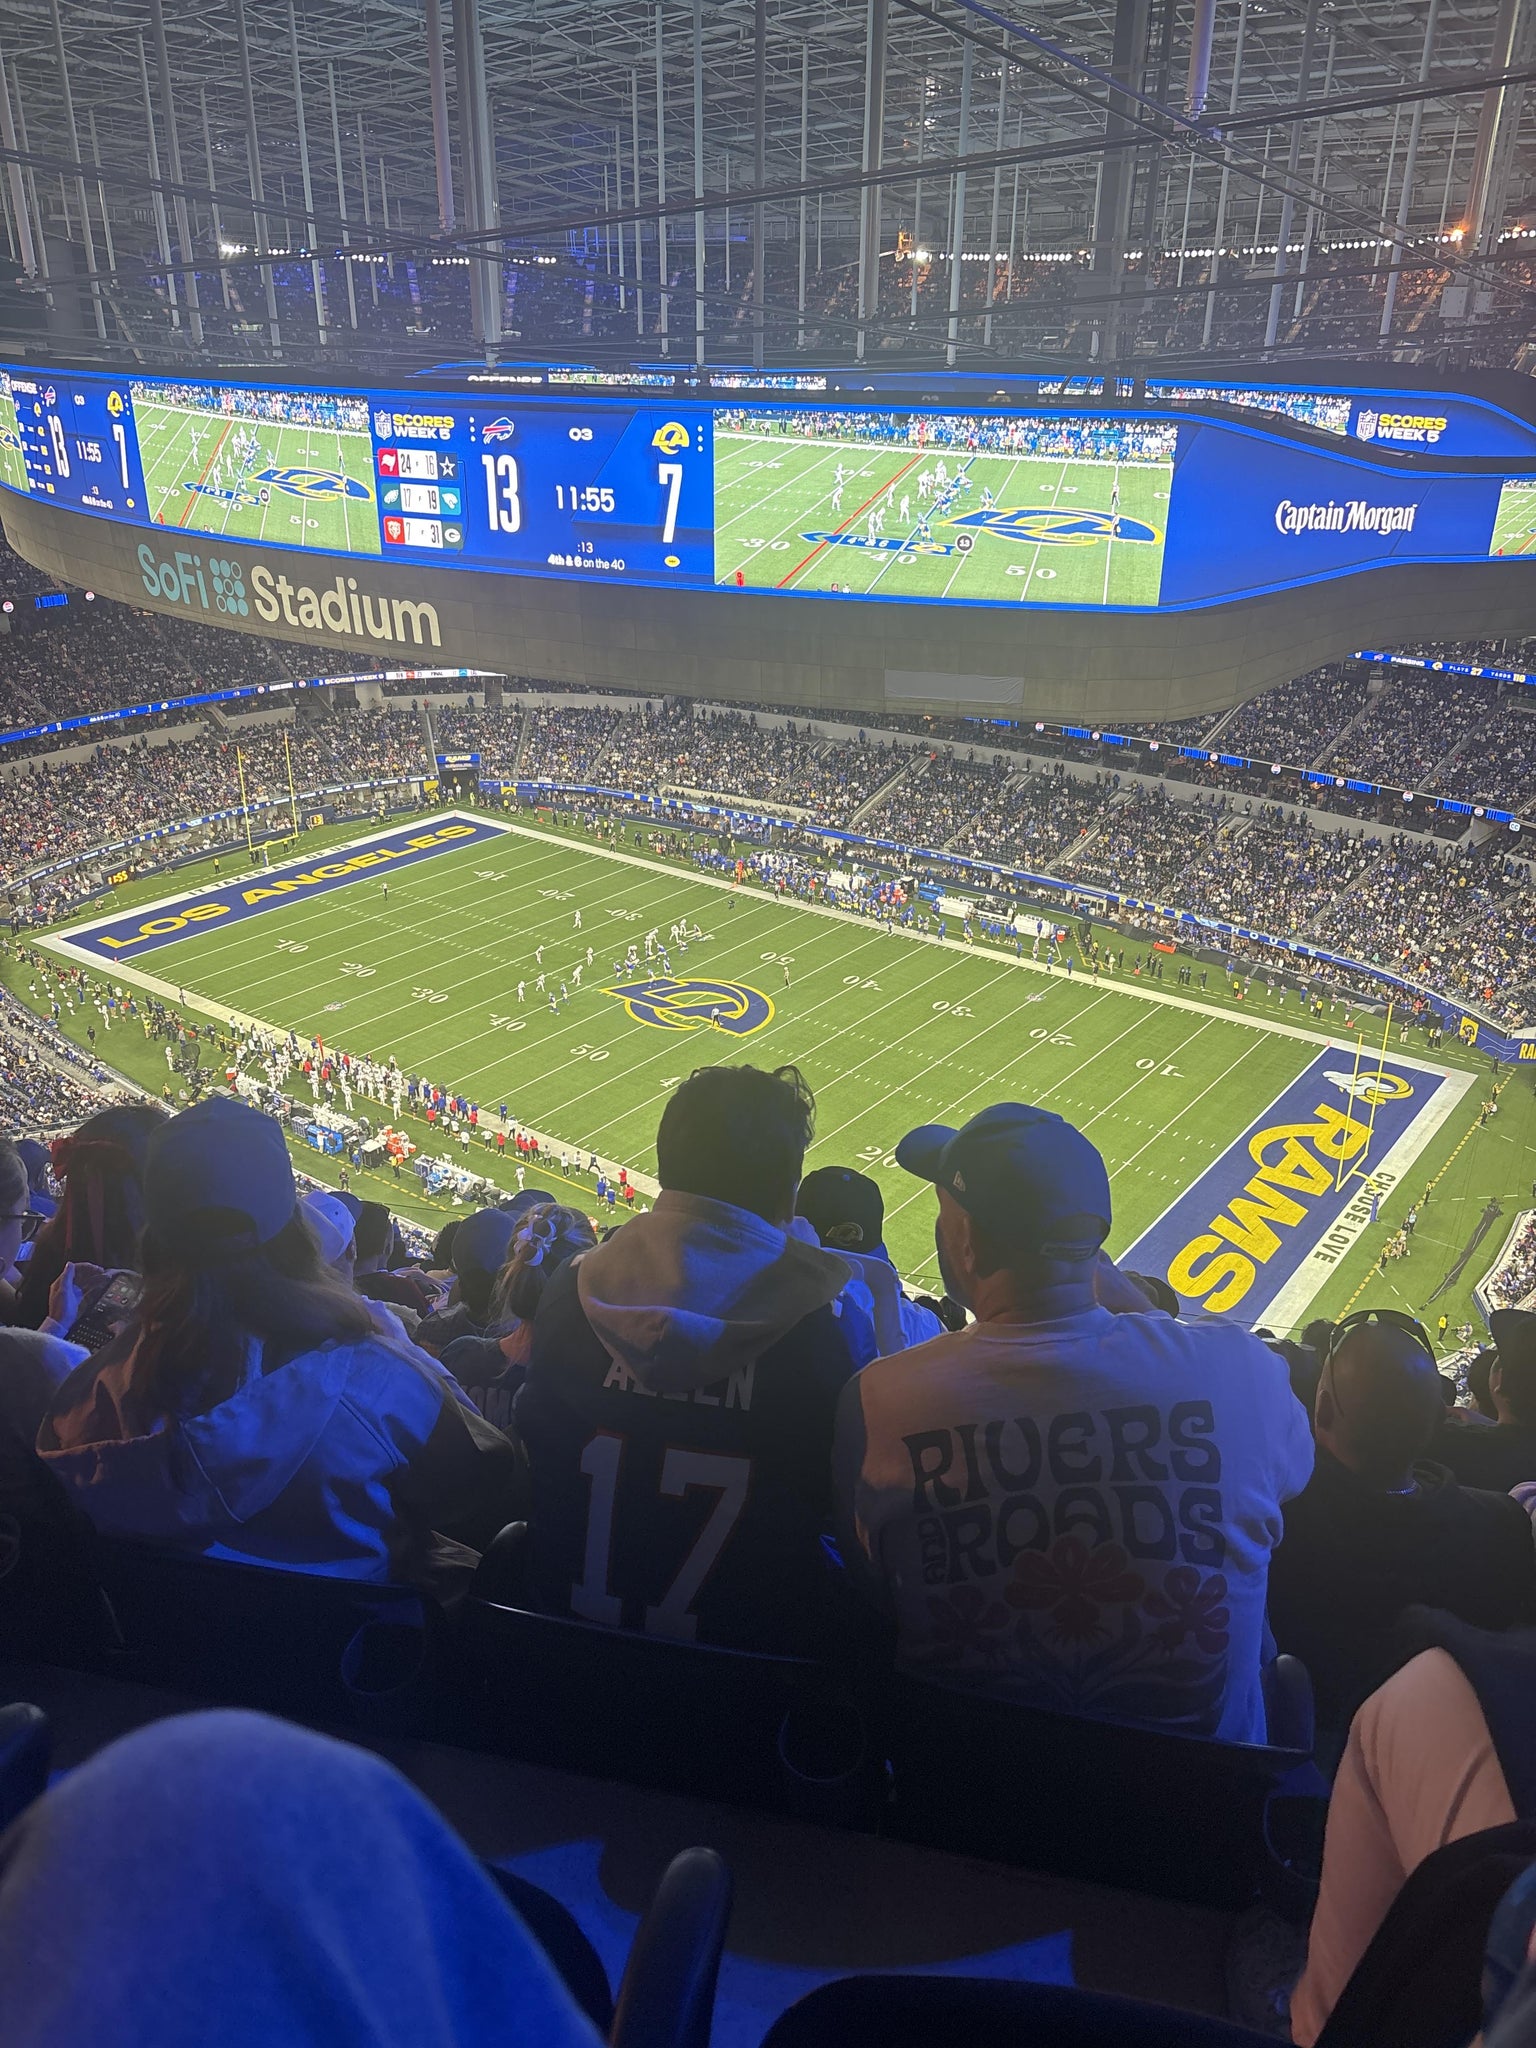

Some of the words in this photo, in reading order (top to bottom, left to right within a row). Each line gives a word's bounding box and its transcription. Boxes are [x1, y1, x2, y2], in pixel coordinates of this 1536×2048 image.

[392, 414, 455, 429] SCORES
[1378, 413, 1447, 430] SCORES
[393, 425, 438, 439] WEEK
[1377, 426, 1427, 442] WEEK
[1427, 429, 1440, 443] 5
[47, 415, 70, 478] 13
[76, 440, 102, 463] 11:55
[112, 423, 129, 489] 7
[400, 453, 412, 473] 24
[425, 454, 435, 475] 16
[403, 488, 412, 508] 17
[427, 489, 438, 510] 19
[481, 454, 522, 533] 13
[554, 484, 615, 513] 11:55
[658, 463, 683, 543] 7
[1275, 500, 1344, 535] Captain
[1341, 500, 1416, 535] Morgan
[406, 521, 411, 541] 7
[430, 524, 440, 544] 31
[577, 541, 594, 554] :13
[743, 538, 791, 550] 30
[547, 554, 565, 566] 4th
[565, 555, 574, 567] &
[574, 556, 582, 568] 6
[583, 559, 594, 569] on
[595, 558, 609, 570] the
[610, 559, 625, 571] 40
[869, 551, 917, 564] 40
[1004, 565, 1057, 579] 50
[137, 544, 209, 609] SoFi
[251, 565, 442, 647] Stadium
[1390, 656, 1425, 668] PASSING
[1449, 665, 1469, 673] PLAYS
[325, 675, 355, 686] SCORES
[356, 673, 378, 683] WEEK
[209, 804, 259, 821] HOUSE
[719, 808, 782, 826] HOUSE
[188, 887, 206, 896] IT
[213, 870, 267, 889] TAKES
[268, 857, 302, 871] ALL
[306, 850, 325, 860] OF
[331, 843, 354, 853] US
[97, 903, 232, 949] LOS
[242, 825, 478, 906] ANGELES
[274, 939, 309, 954] 10
[1231, 926, 1317, 958] HOUSE
[338, 963, 377, 978] 20
[410, 988, 449, 1004] 30
[488, 1016, 527, 1032] 40
[569, 1043, 610, 1062] 50
[1518, 1043, 1536, 1060] RA
[855, 1146, 899, 1169] 20
[1167, 1103, 1374, 1313] RAMS
[1344, 1171, 1396, 1225] CHOOSE
[1313, 1219, 1358, 1264] LOVE
[570, 1430, 754, 1642] 17
[939, 1486, 1227, 1586] ROADS
